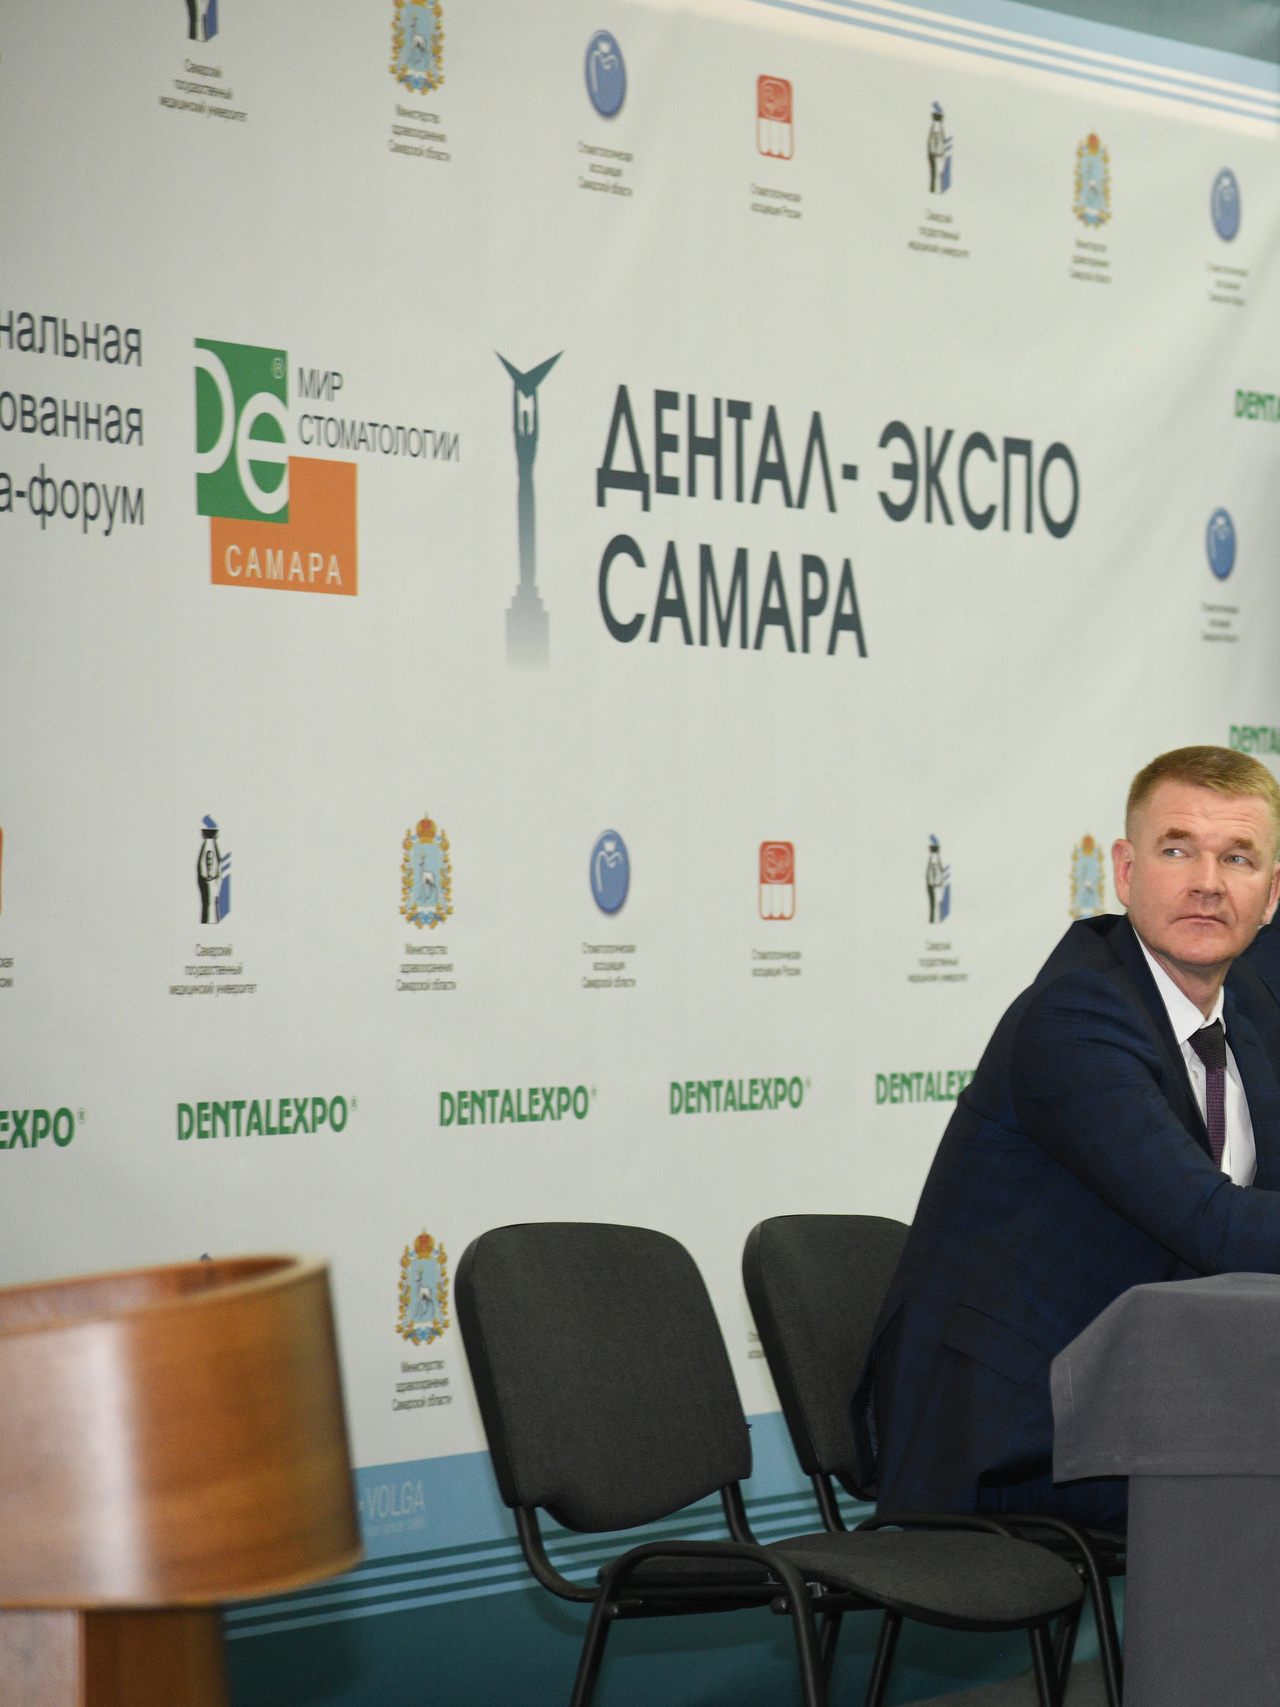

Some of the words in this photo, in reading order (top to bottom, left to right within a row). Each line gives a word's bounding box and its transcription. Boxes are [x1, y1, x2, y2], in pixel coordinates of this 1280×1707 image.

[298, 367, 343, 401] МИР
[299, 414, 459, 462] СТОМАТОЛОГИИ
[596, 384, 858, 513] ДЕНТАЛ-
[878, 420, 1080, 539] ЭКСПО
[225, 545, 342, 586] САМАРА
[598, 533, 868, 658] САМАРА
[439, 1084, 589, 1127] DENTALEXPO
[669, 1075, 803, 1115] DENTALEXPO
[177, 1095, 348, 1141] DENTALEXPO
